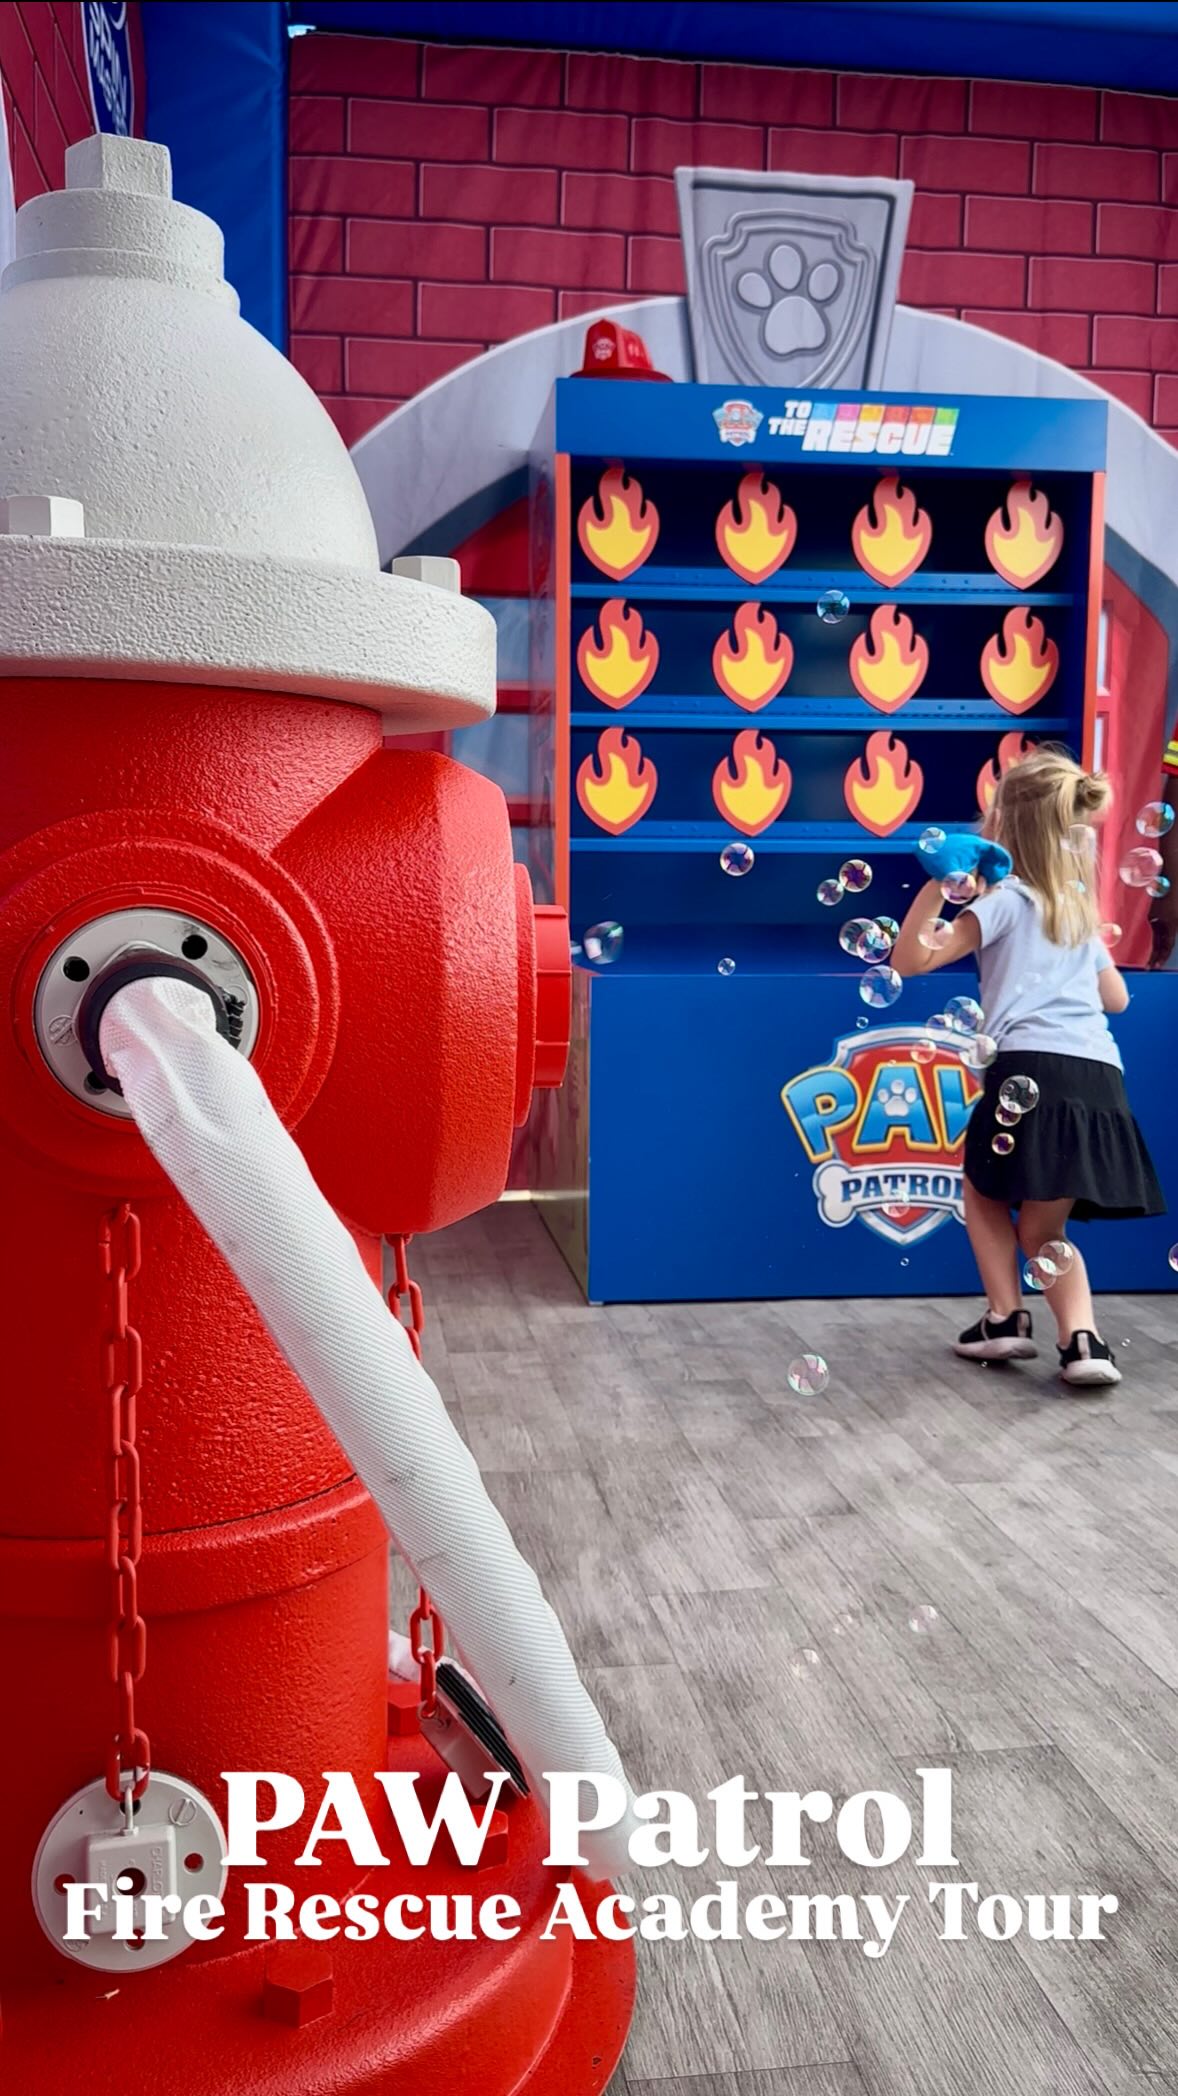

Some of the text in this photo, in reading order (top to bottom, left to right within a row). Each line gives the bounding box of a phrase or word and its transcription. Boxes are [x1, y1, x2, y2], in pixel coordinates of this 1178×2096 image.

[784, 400, 812, 418] TO
[768, 418, 806, 436] THE
[802, 417, 957, 457] RESCUE
